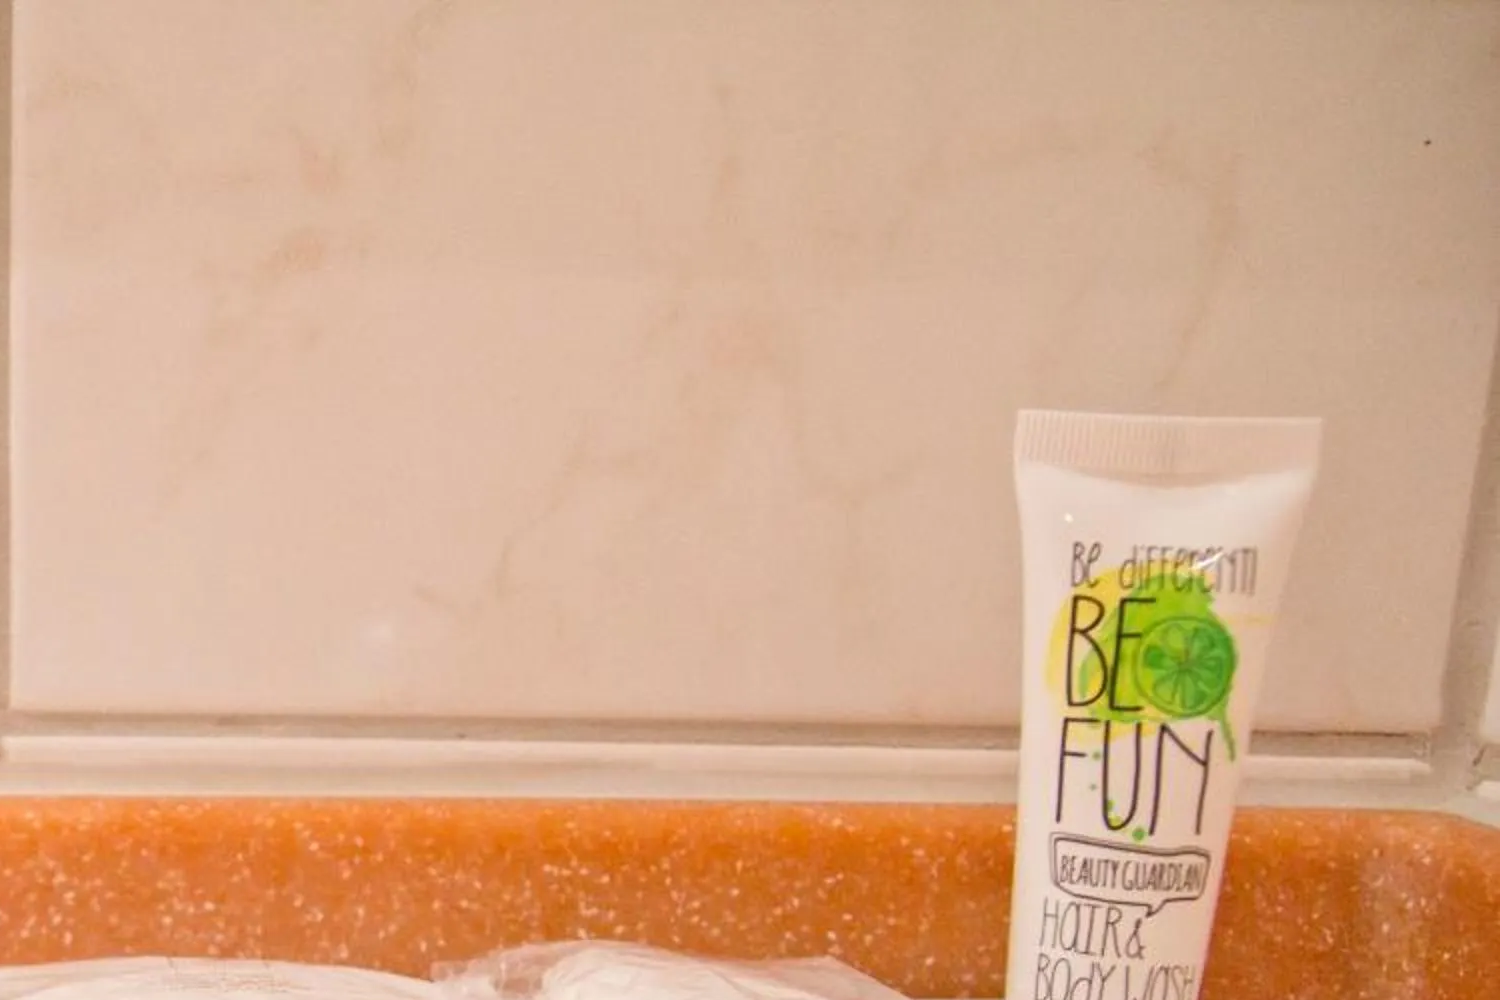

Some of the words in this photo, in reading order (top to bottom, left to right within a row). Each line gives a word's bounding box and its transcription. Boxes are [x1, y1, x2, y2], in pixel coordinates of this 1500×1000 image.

[1066, 594, 1156, 712] BE
[1056, 717, 1214, 836] FUN
[1059, 855, 1120, 889] BEAUTY
[1121, 860, 1201, 893] GUARDIAN
[1125, 917, 1146, 960] &
